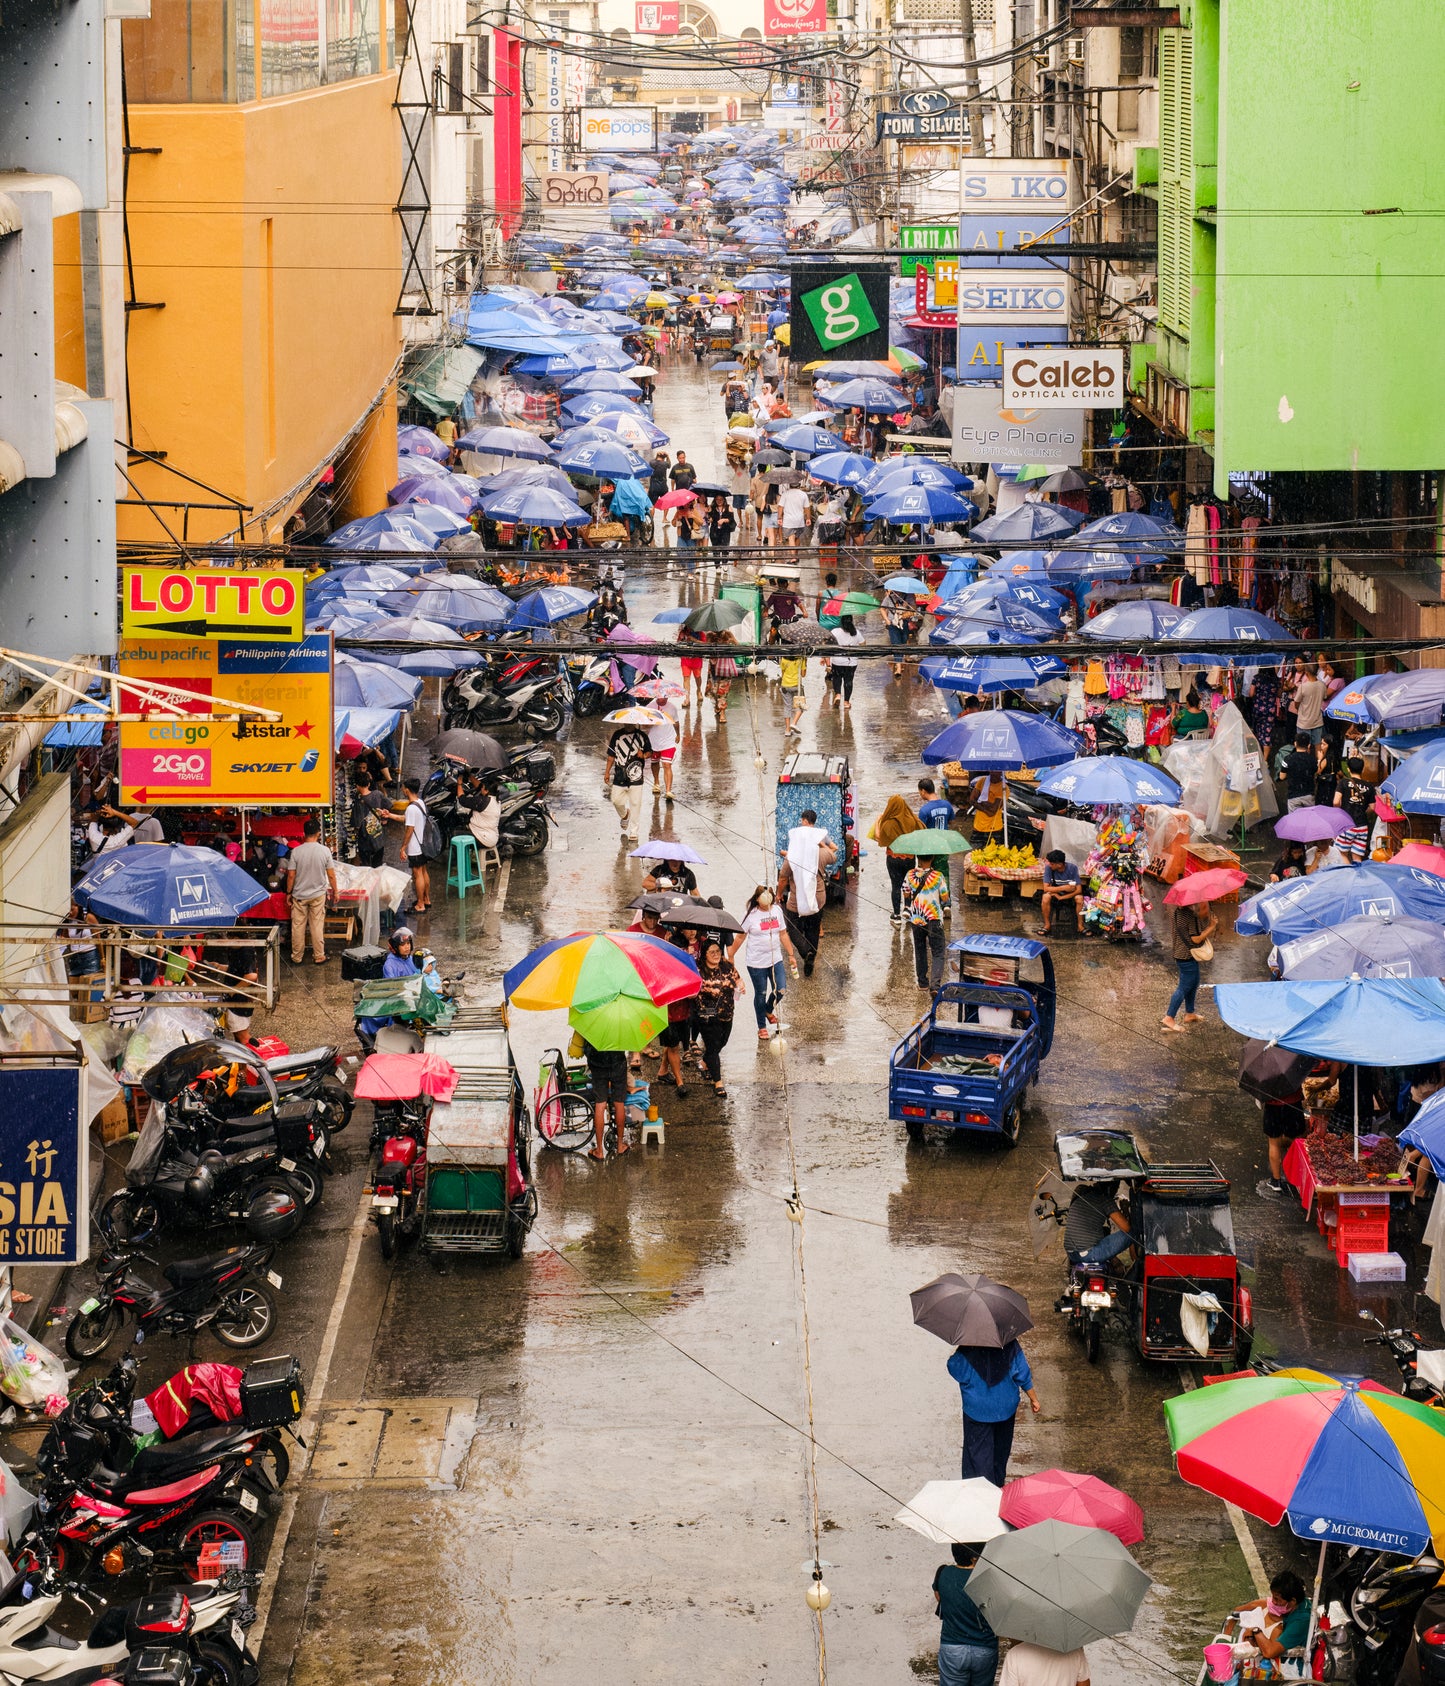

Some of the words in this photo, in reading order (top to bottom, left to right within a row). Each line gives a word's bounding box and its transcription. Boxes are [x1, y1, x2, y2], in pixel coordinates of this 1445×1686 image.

[769, 18, 815, 30] Chowking
[883, 118, 915, 135] TOM
[546, 186, 604, 207] OptiQ
[963, 288, 1065, 310] SEIKO
[1012, 359, 1115, 388] Caleb
[1012, 390, 1066, 399] OPTICAL
[1072, 390, 1115, 398] CLINIC
[961, 426, 1000, 446] Eye
[1007, 428, 1075, 444] Phoria
[973, 447, 1023, 457] OPTICAL
[1024, 449, 1062, 458] CLINIC
[129, 574, 297, 616] LOTTO
[121, 646, 158, 660] cebu
[160, 646, 212, 664] pacific
[235, 649, 286, 660] Philippine
[288, 648, 327, 658] Airlines
[236, 680, 312, 706] tigerair
[149, 721, 210, 744] cebgo
[232, 722, 292, 739] Jetstar
[152, 754, 205, 773] 2GO
[229, 763, 297, 773] SKYJET
[177, 772, 205, 781] TRAVEL
[170, 908, 204, 924] AMERICAN
[25, 1139, 58, 1179] 行
[15, 1228, 66, 1255] STORE
[1331, 1523, 1409, 1547] MICROMATIC
